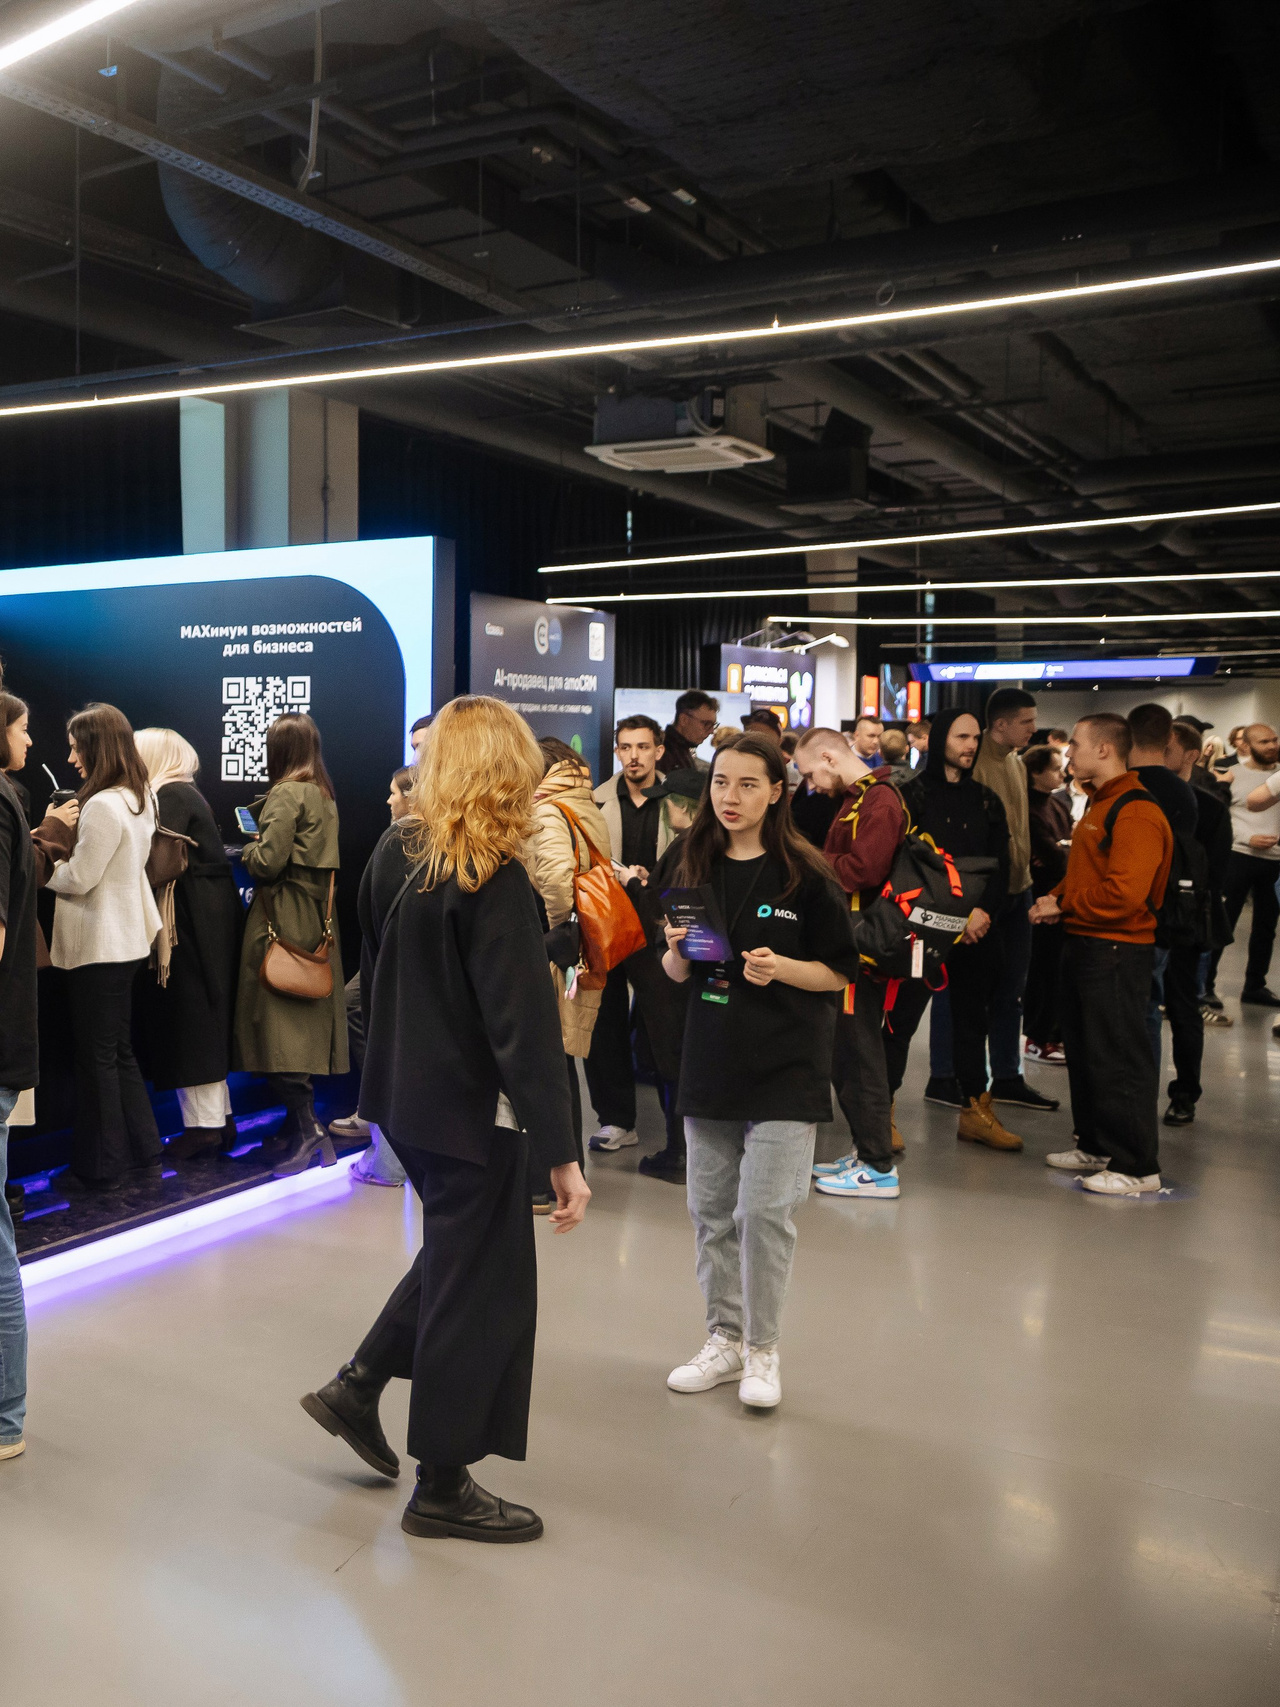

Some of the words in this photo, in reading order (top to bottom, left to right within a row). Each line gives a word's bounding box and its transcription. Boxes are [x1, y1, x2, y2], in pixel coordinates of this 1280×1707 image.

[251, 617, 362, 636] возможностей
[222, 643, 250, 657] для
[253, 640, 314, 654] бизнеса
[548, 675, 563, 691] для
